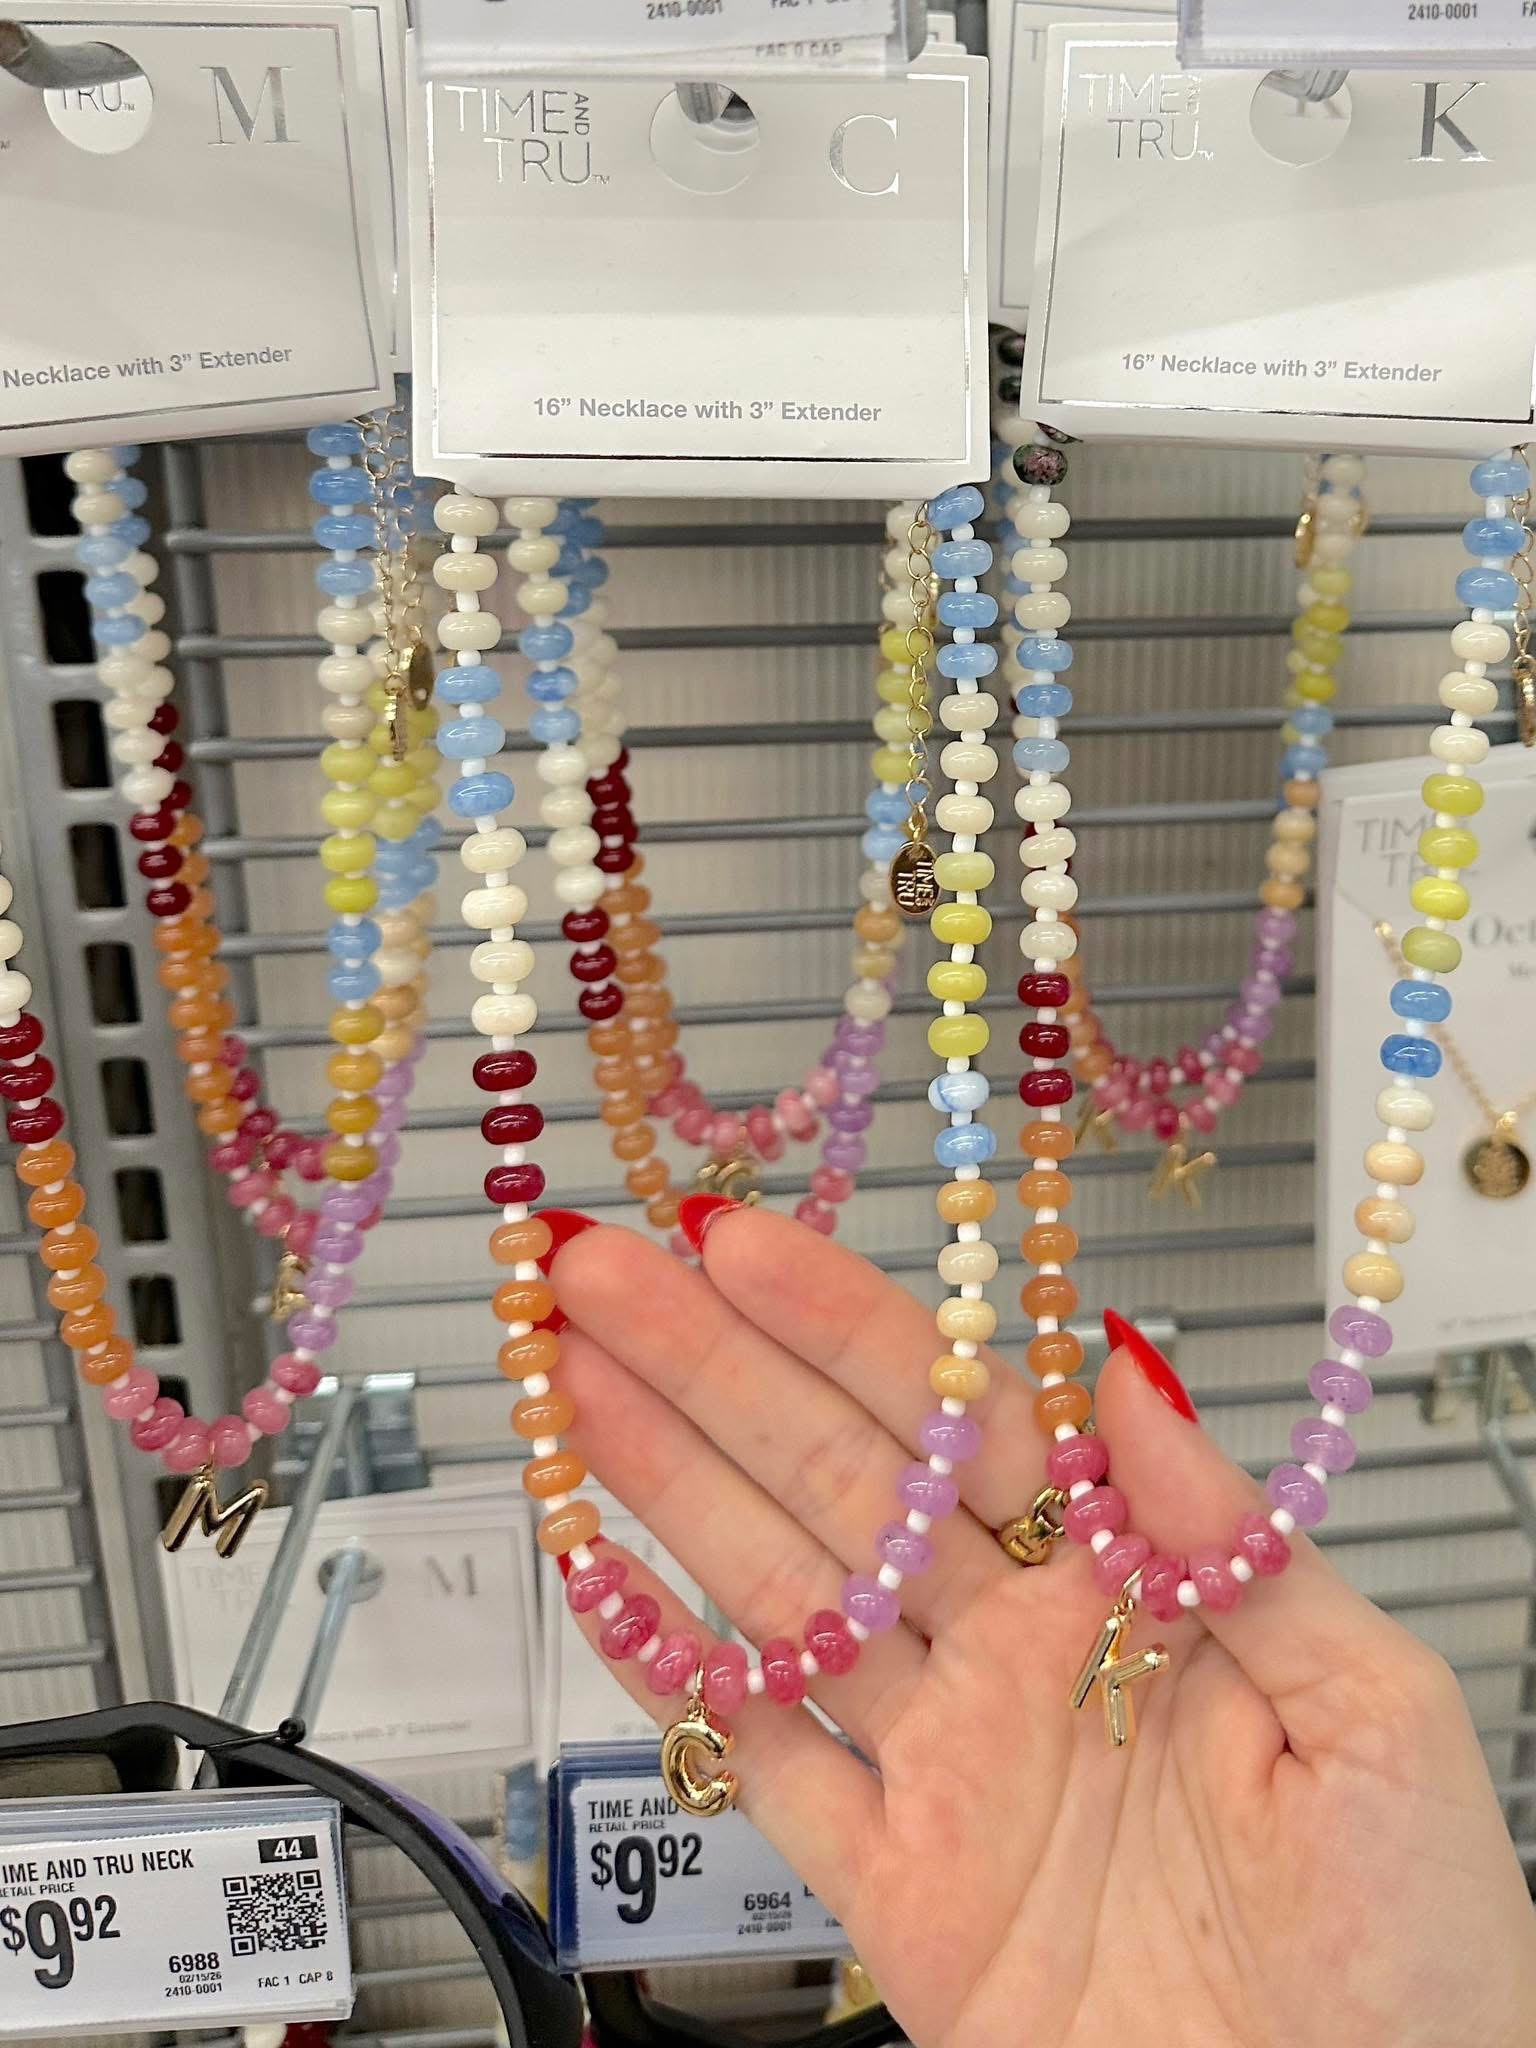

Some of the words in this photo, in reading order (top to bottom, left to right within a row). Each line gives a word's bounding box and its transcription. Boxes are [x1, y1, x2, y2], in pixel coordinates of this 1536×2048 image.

[1407, 3, 1478, 20] 2410-0001
[200, 66, 301, 145] M
[444, 85, 569, 134] TIME
[1079, 73, 1184, 114] TIME
[574, 92, 590, 136] AND
[1408, 81, 1496, 163] K
[829, 114, 900, 196] C
[1107, 119, 1199, 160] TRU
[483, 137, 591, 184] TRU
[2, 364, 110, 389] Necklace
[117, 357, 163, 377] with
[199, 346, 292, 369] Extender
[1161, 354, 1257, 375] Necklace
[1263, 359, 1307, 377] with
[1344, 361, 1442, 382] Extender
[579, 398, 687, 418] Necklace
[695, 400, 742, 419] with
[781, 402, 882, 421] Extender
[1353, 816, 1427, 854] TIM
[588, 1799, 633, 1820] TIME
[641, 1797, 678, 1817] AND
[589, 1821, 628, 1833] RETAIL
[632, 1819, 666, 1831] PRICE
[2, 1862, 39, 1884] IME
[46, 1858, 87, 1881] AND
[93, 1853, 134, 1876] TRU
[142, 1848, 195, 1872] NECK
[274, 1838, 303, 1859] 44
[40, 1881, 76, 1895] PRICE
[744, 1891, 792, 1911] 6964
[168, 1952, 220, 1973] 6988
[165, 1982, 223, 1997] 2410-0001
[258, 1976, 280, 1988] FAC
[299, 1971, 322, 1984] CAP
